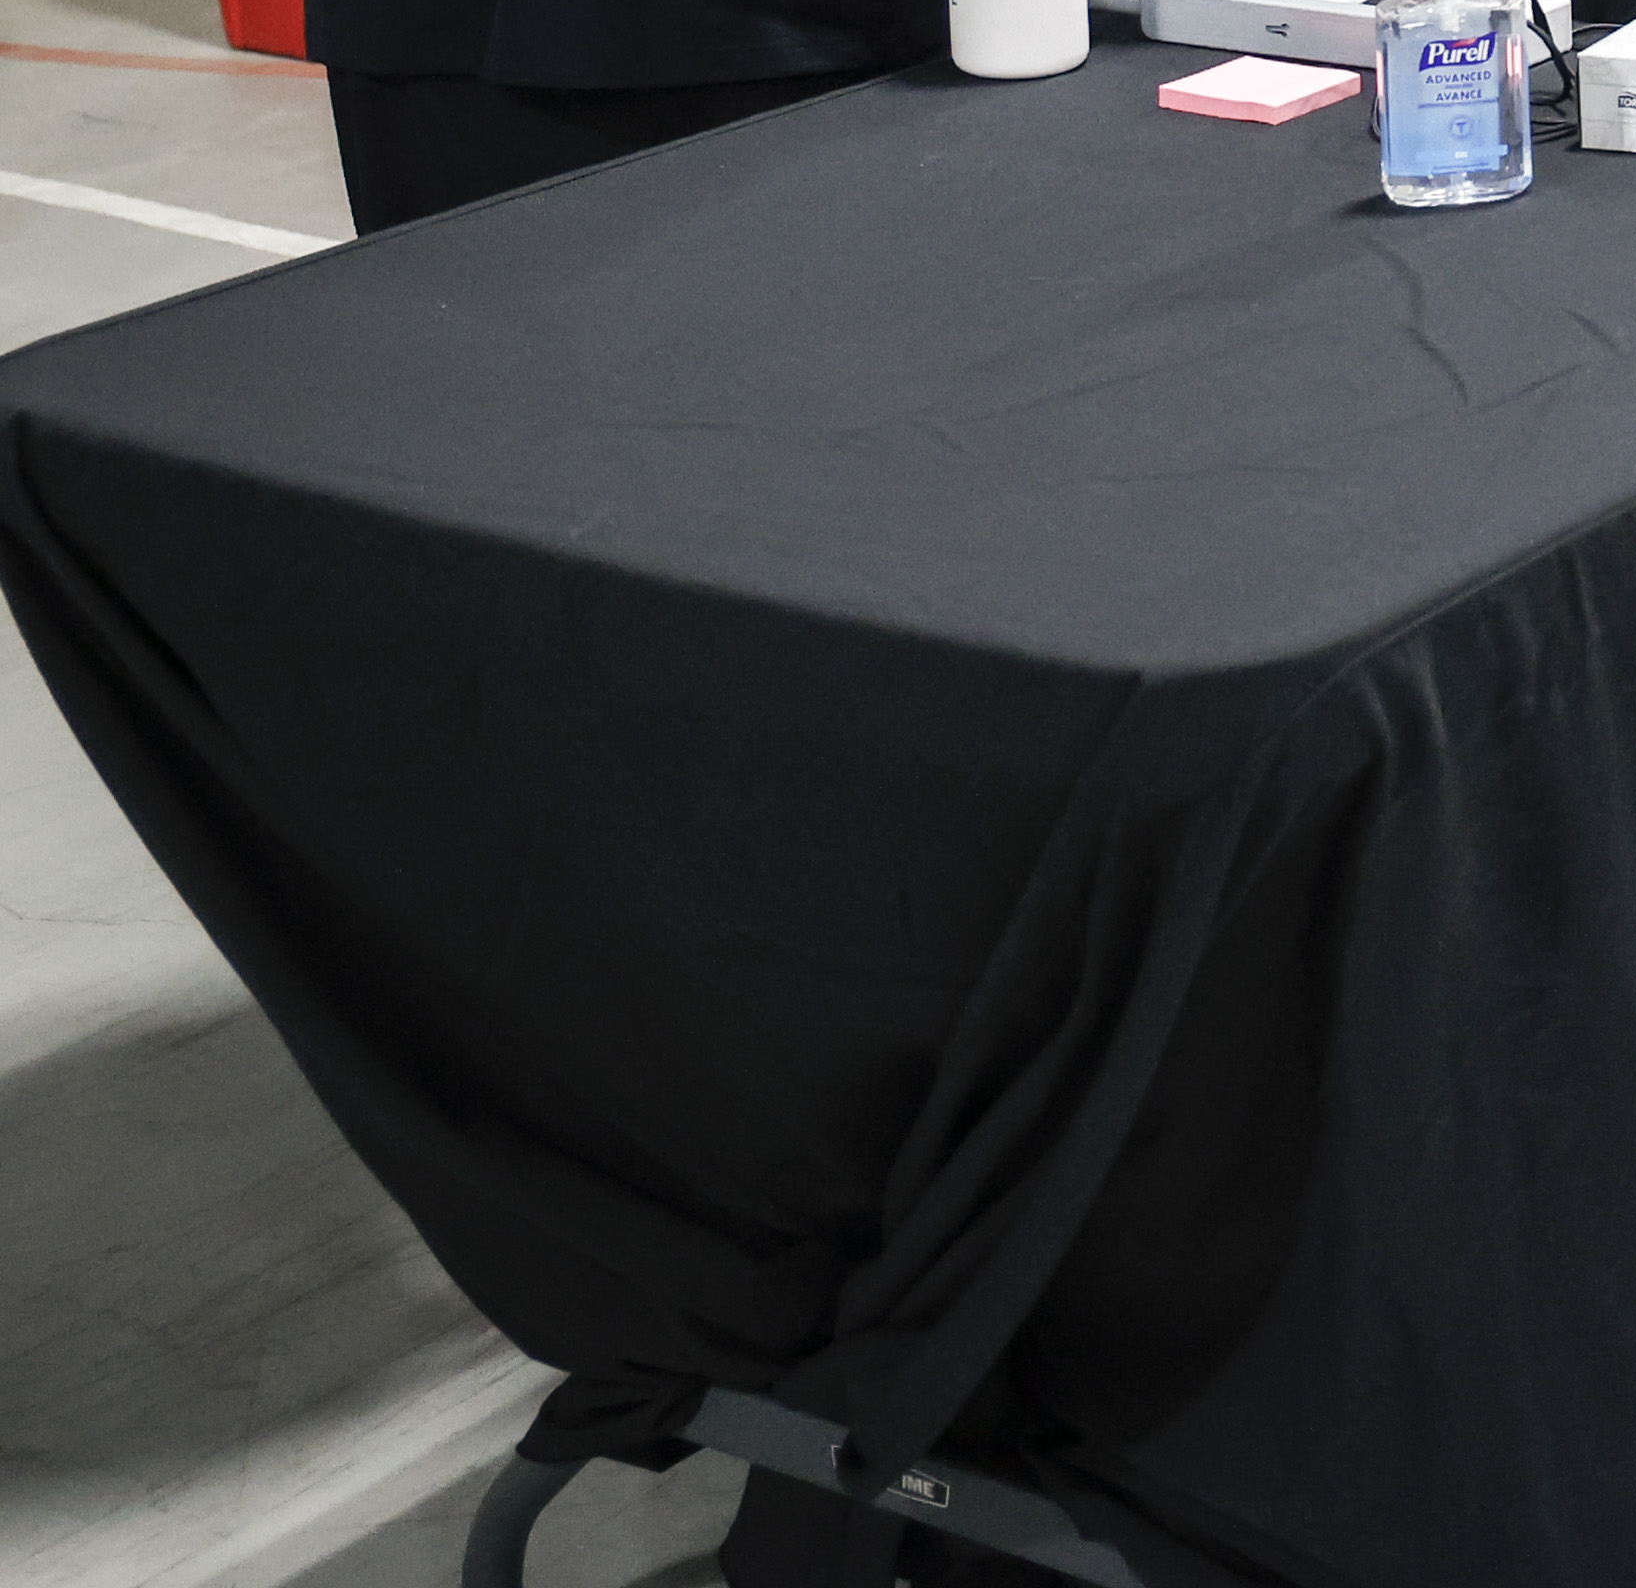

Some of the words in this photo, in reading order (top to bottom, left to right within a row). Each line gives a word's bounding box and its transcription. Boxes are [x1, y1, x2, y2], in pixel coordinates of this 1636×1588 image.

[1428, 39, 1490, 65] Purell
[1425, 71, 1492, 84] ADVANCED
[902, 1474, 935, 1499] IME
